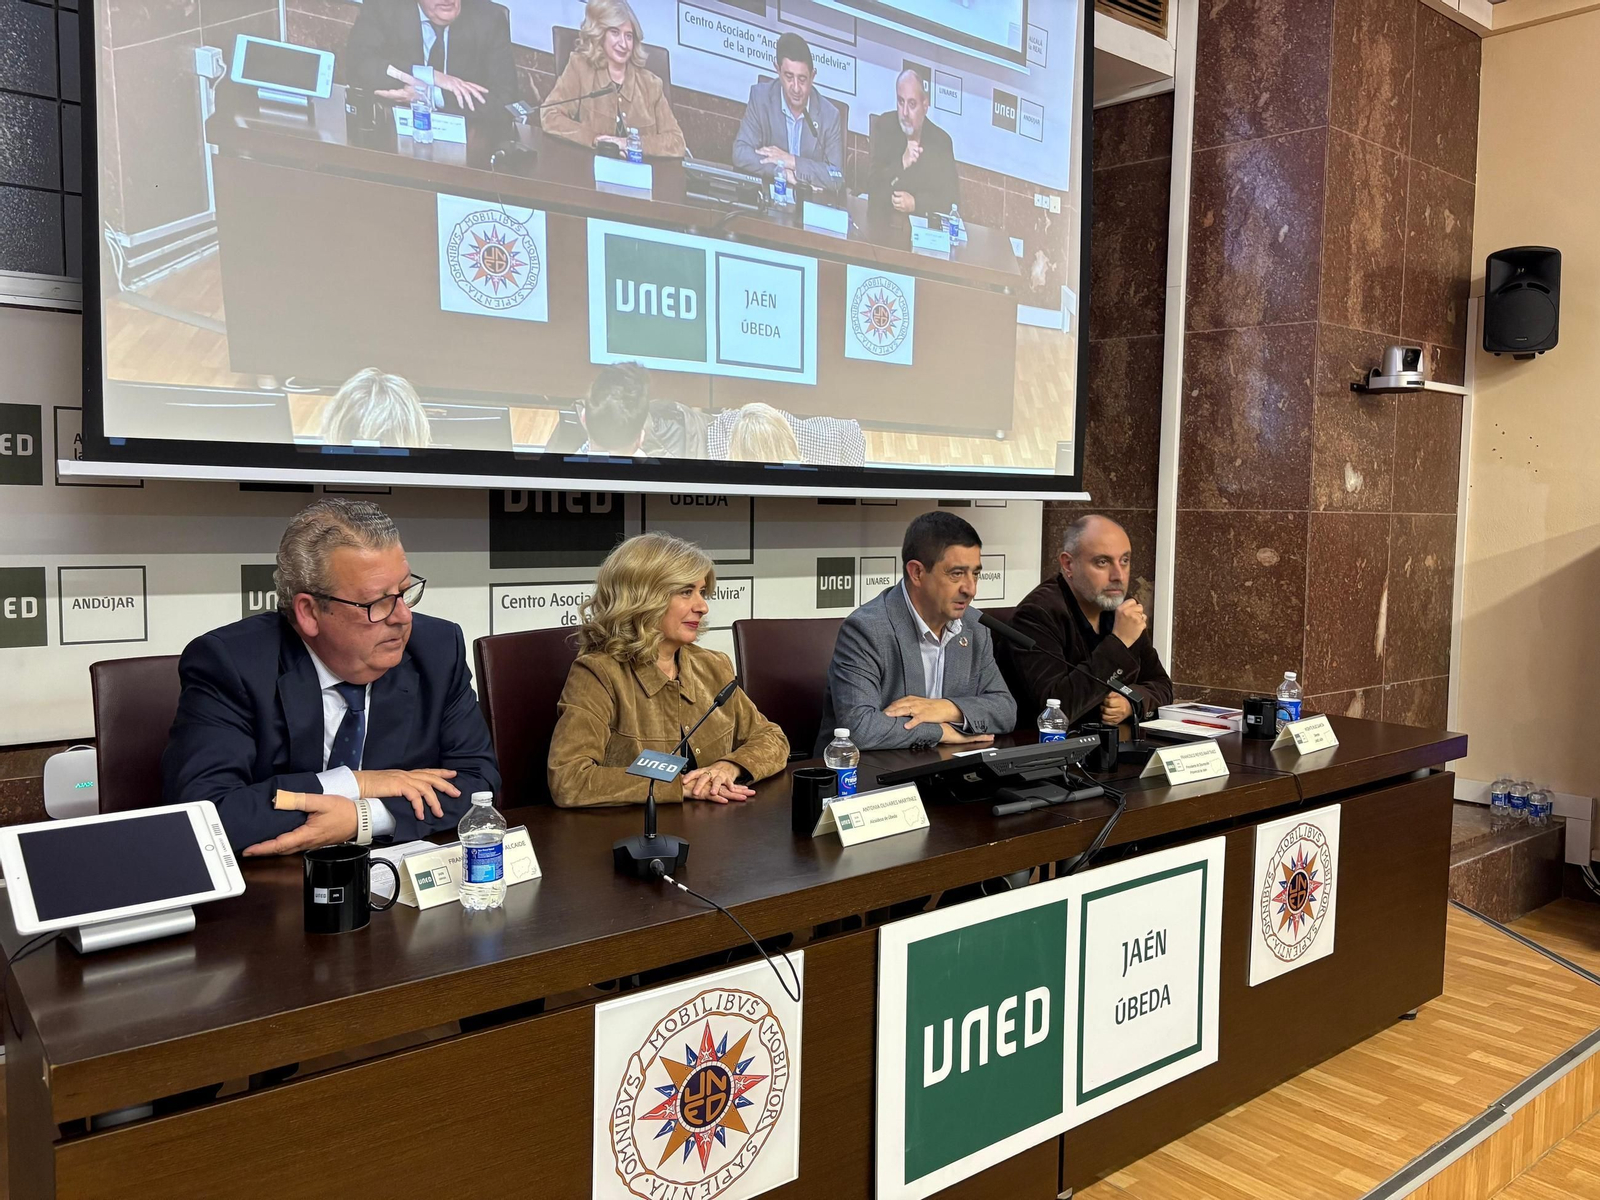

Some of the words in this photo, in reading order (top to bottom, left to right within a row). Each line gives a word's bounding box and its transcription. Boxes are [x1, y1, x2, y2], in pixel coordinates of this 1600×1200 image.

[684, 11, 714, 30] Centro
[716, 21, 755, 43] Asociado
[757, 34, 778, 49] “And
[811, 52, 851, 71] andelvira”
[723, 37, 735, 50] de
[737, 41, 745, 53] la
[939, 88, 958, 99] LINARES
[994, 102, 1016, 120] UNED
[615, 278, 698, 320] UNED
[744, 290, 778, 309] JAÉN
[741, 319, 781, 338] ÚBEDA
[0, 433, 34, 456] ED
[820, 575, 852, 591] UNED
[866, 577, 890, 586] LINARES
[3, 596, 38, 619] ED
[72, 596, 135, 611] ANDÚJAR
[501, 594, 546, 610] Centro
[561, 610, 577, 626] de
[637, 757, 678, 774] UNED
[75, 781, 94, 789] AJAX
[1121, 929, 1167, 978] JAÉN
[1114, 984, 1172, 1025] ÚBEDA
[649, 993, 760, 1052] MOBILIBVS
[923, 986, 1051, 1089] UNED
[762, 1023, 787, 1125] MOBILIOR
[615, 1074, 641, 1175] OMNIBVS
